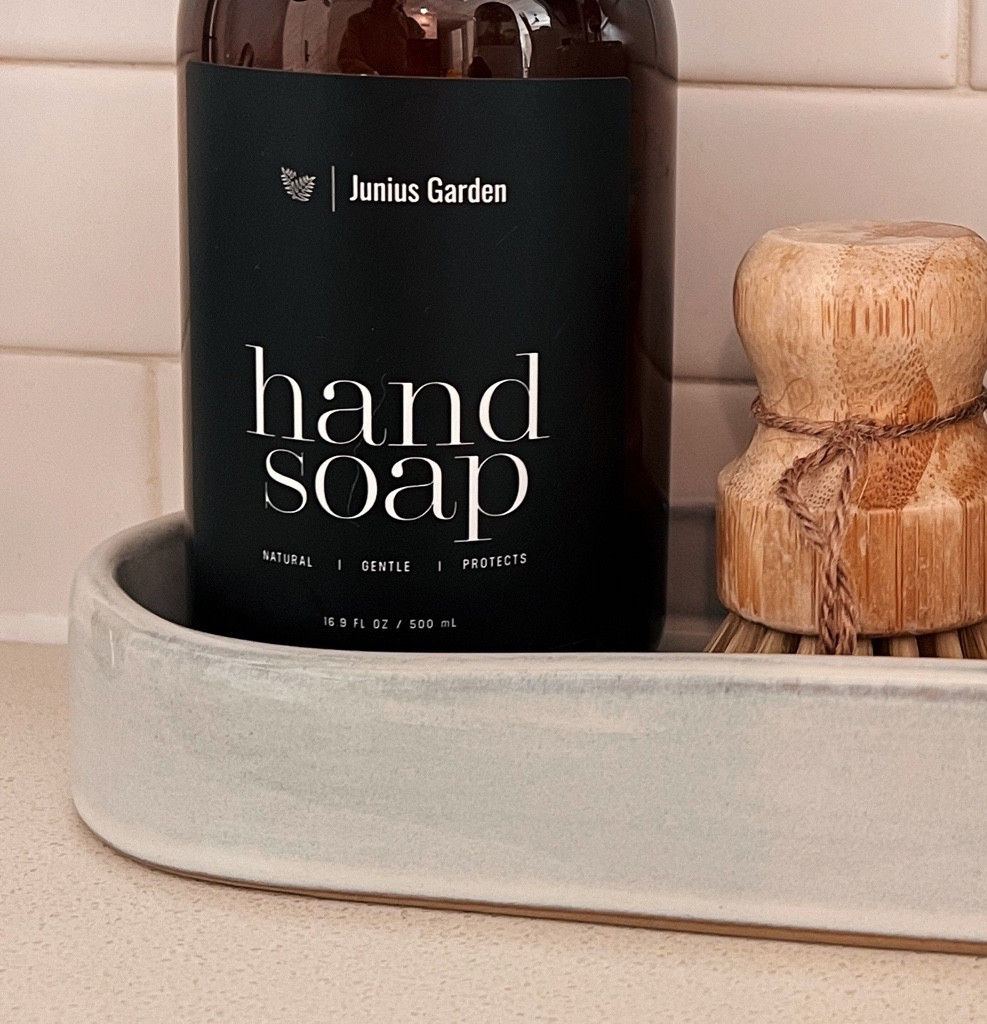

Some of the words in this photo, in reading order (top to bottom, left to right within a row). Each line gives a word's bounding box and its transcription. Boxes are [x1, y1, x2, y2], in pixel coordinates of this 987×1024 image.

[350, 174, 420, 203] Junius
[427, 176, 507, 204] Garden
[245, 343, 550, 447] hand
[265, 448, 529, 543] soap
[262, 549, 313, 568] NATURAL
[361, 560, 411, 573] GENTLE
[462, 552, 528, 570] PROTECTS
[353, 618, 366, 629] FL
[373, 619, 389, 630] OZ
[409, 619, 434, 629] 500
